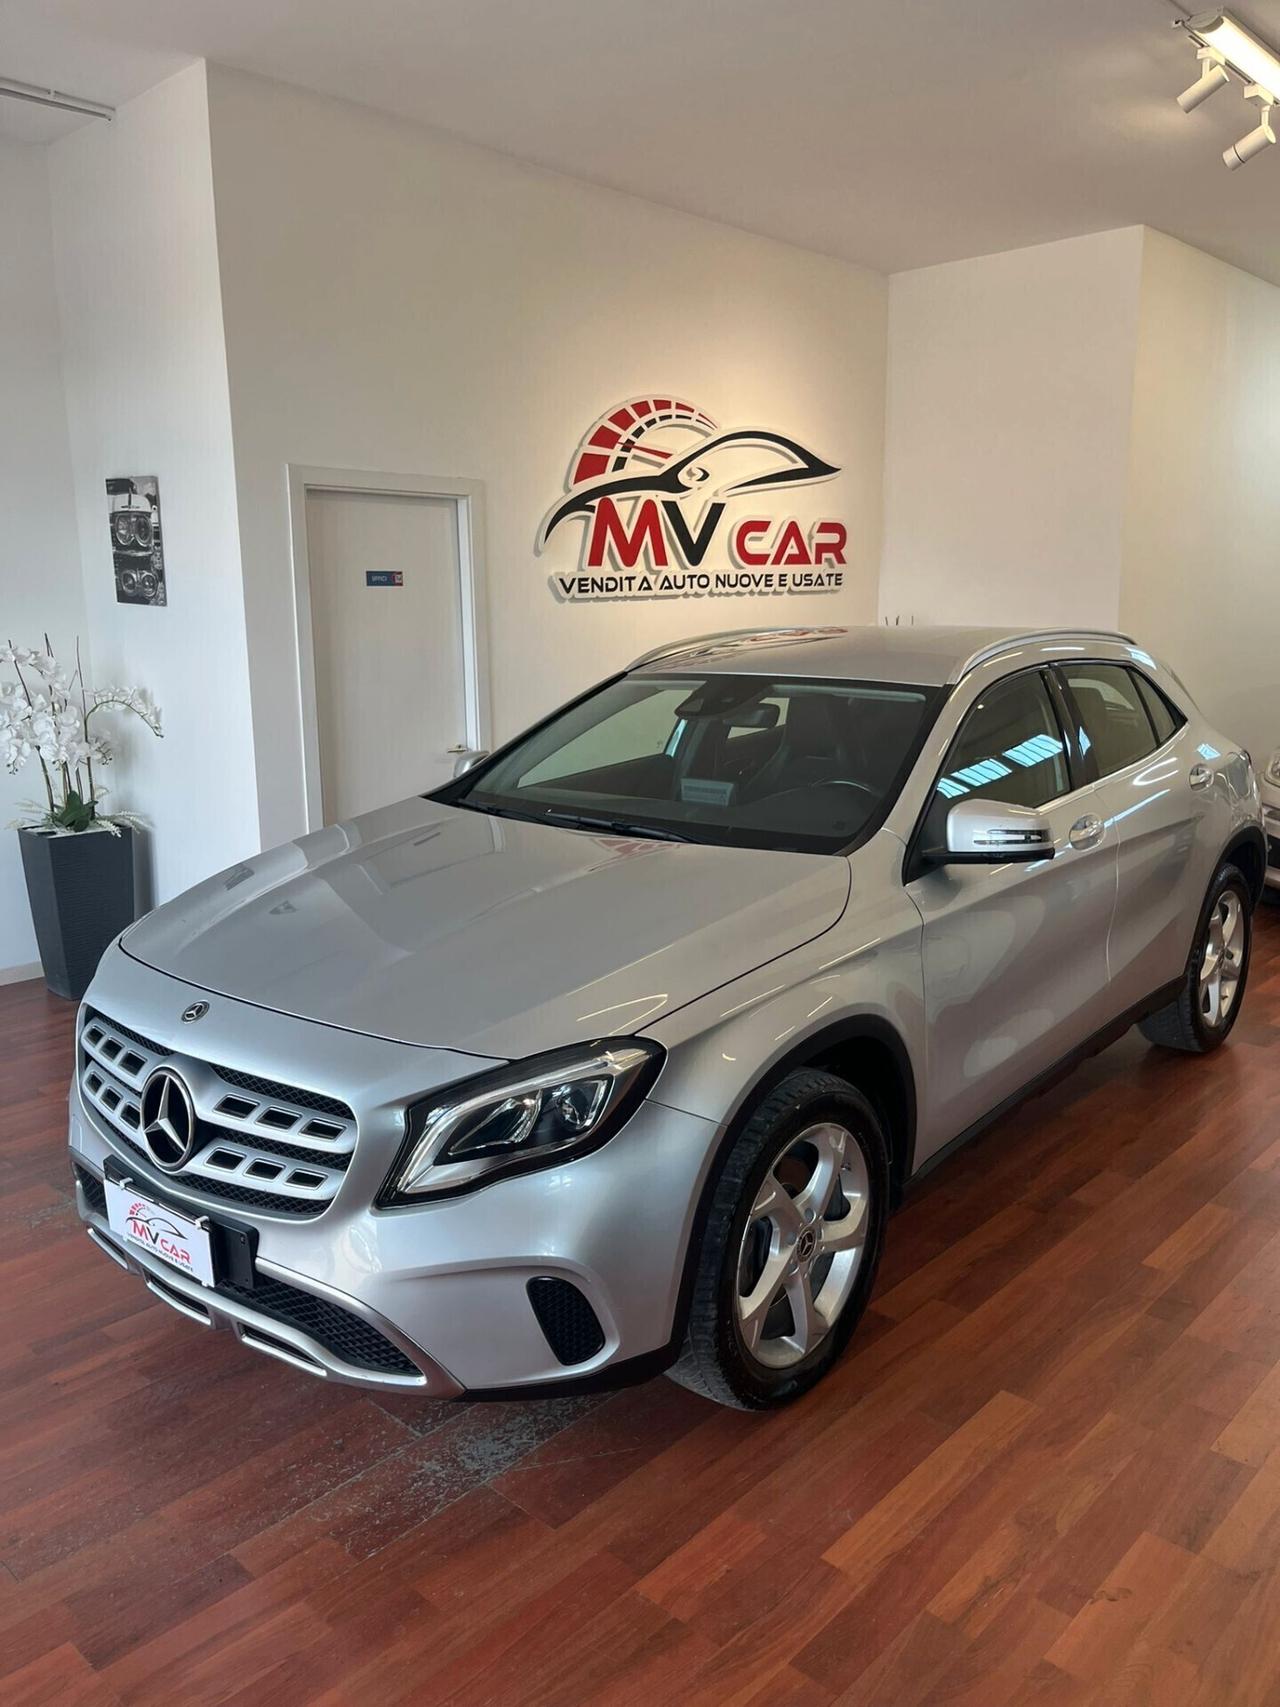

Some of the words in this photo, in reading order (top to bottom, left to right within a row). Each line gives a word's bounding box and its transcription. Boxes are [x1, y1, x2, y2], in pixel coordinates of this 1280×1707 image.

[587, 496, 726, 567] MV
[736, 520, 847, 565] CAR
[558, 575, 653, 594] VENDITA
[659, 574, 710, 590] AUTO
[715, 573, 773, 588] NUOVE
[778, 573, 788, 588] E
[792, 572, 843, 588] USATE
[132, 1220, 160, 1245] MV
[160, 1238, 191, 1265] CAR
